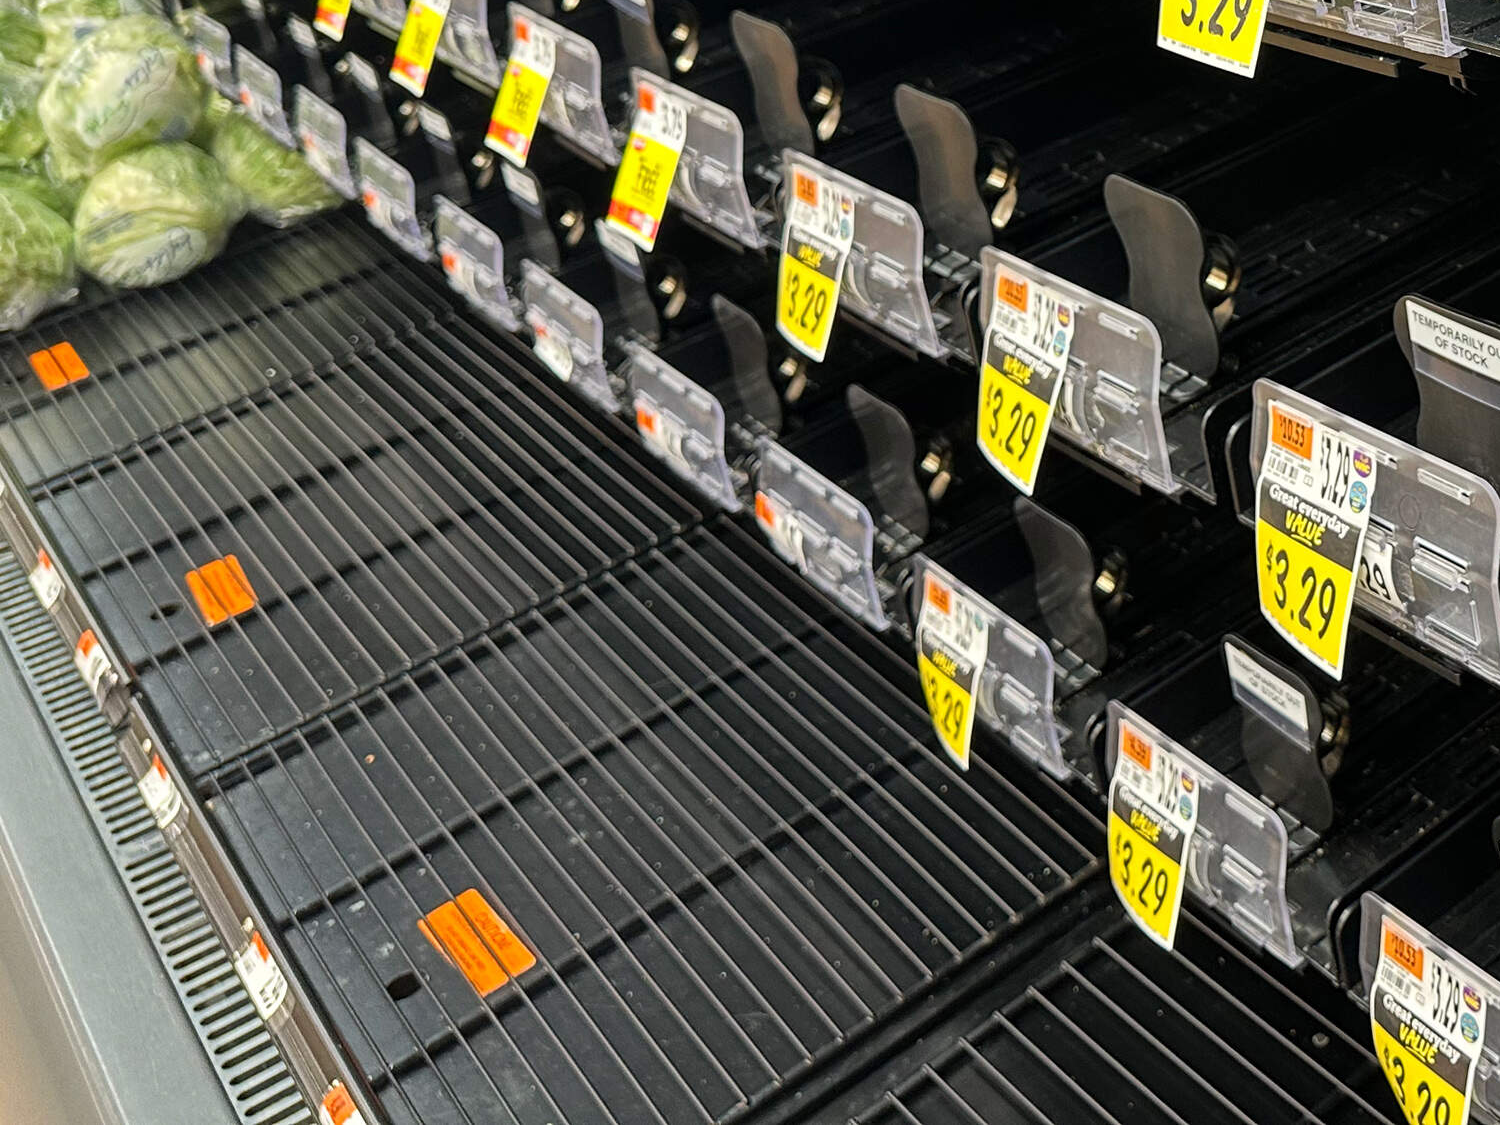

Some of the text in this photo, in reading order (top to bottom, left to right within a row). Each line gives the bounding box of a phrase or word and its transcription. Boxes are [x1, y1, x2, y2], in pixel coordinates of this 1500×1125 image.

[1411, 310, 1485, 352] TEMPORARILY
[1434, 335, 1489, 369] OF STOCK
[1269, 483, 1350, 540] Great everyday
[1285, 510, 1326, 546] VALUE
[1266, 539, 1336, 641] $3.29
[1382, 992, 1462, 1065] Great everyday
[1399, 1022, 1439, 1065] VALUE
